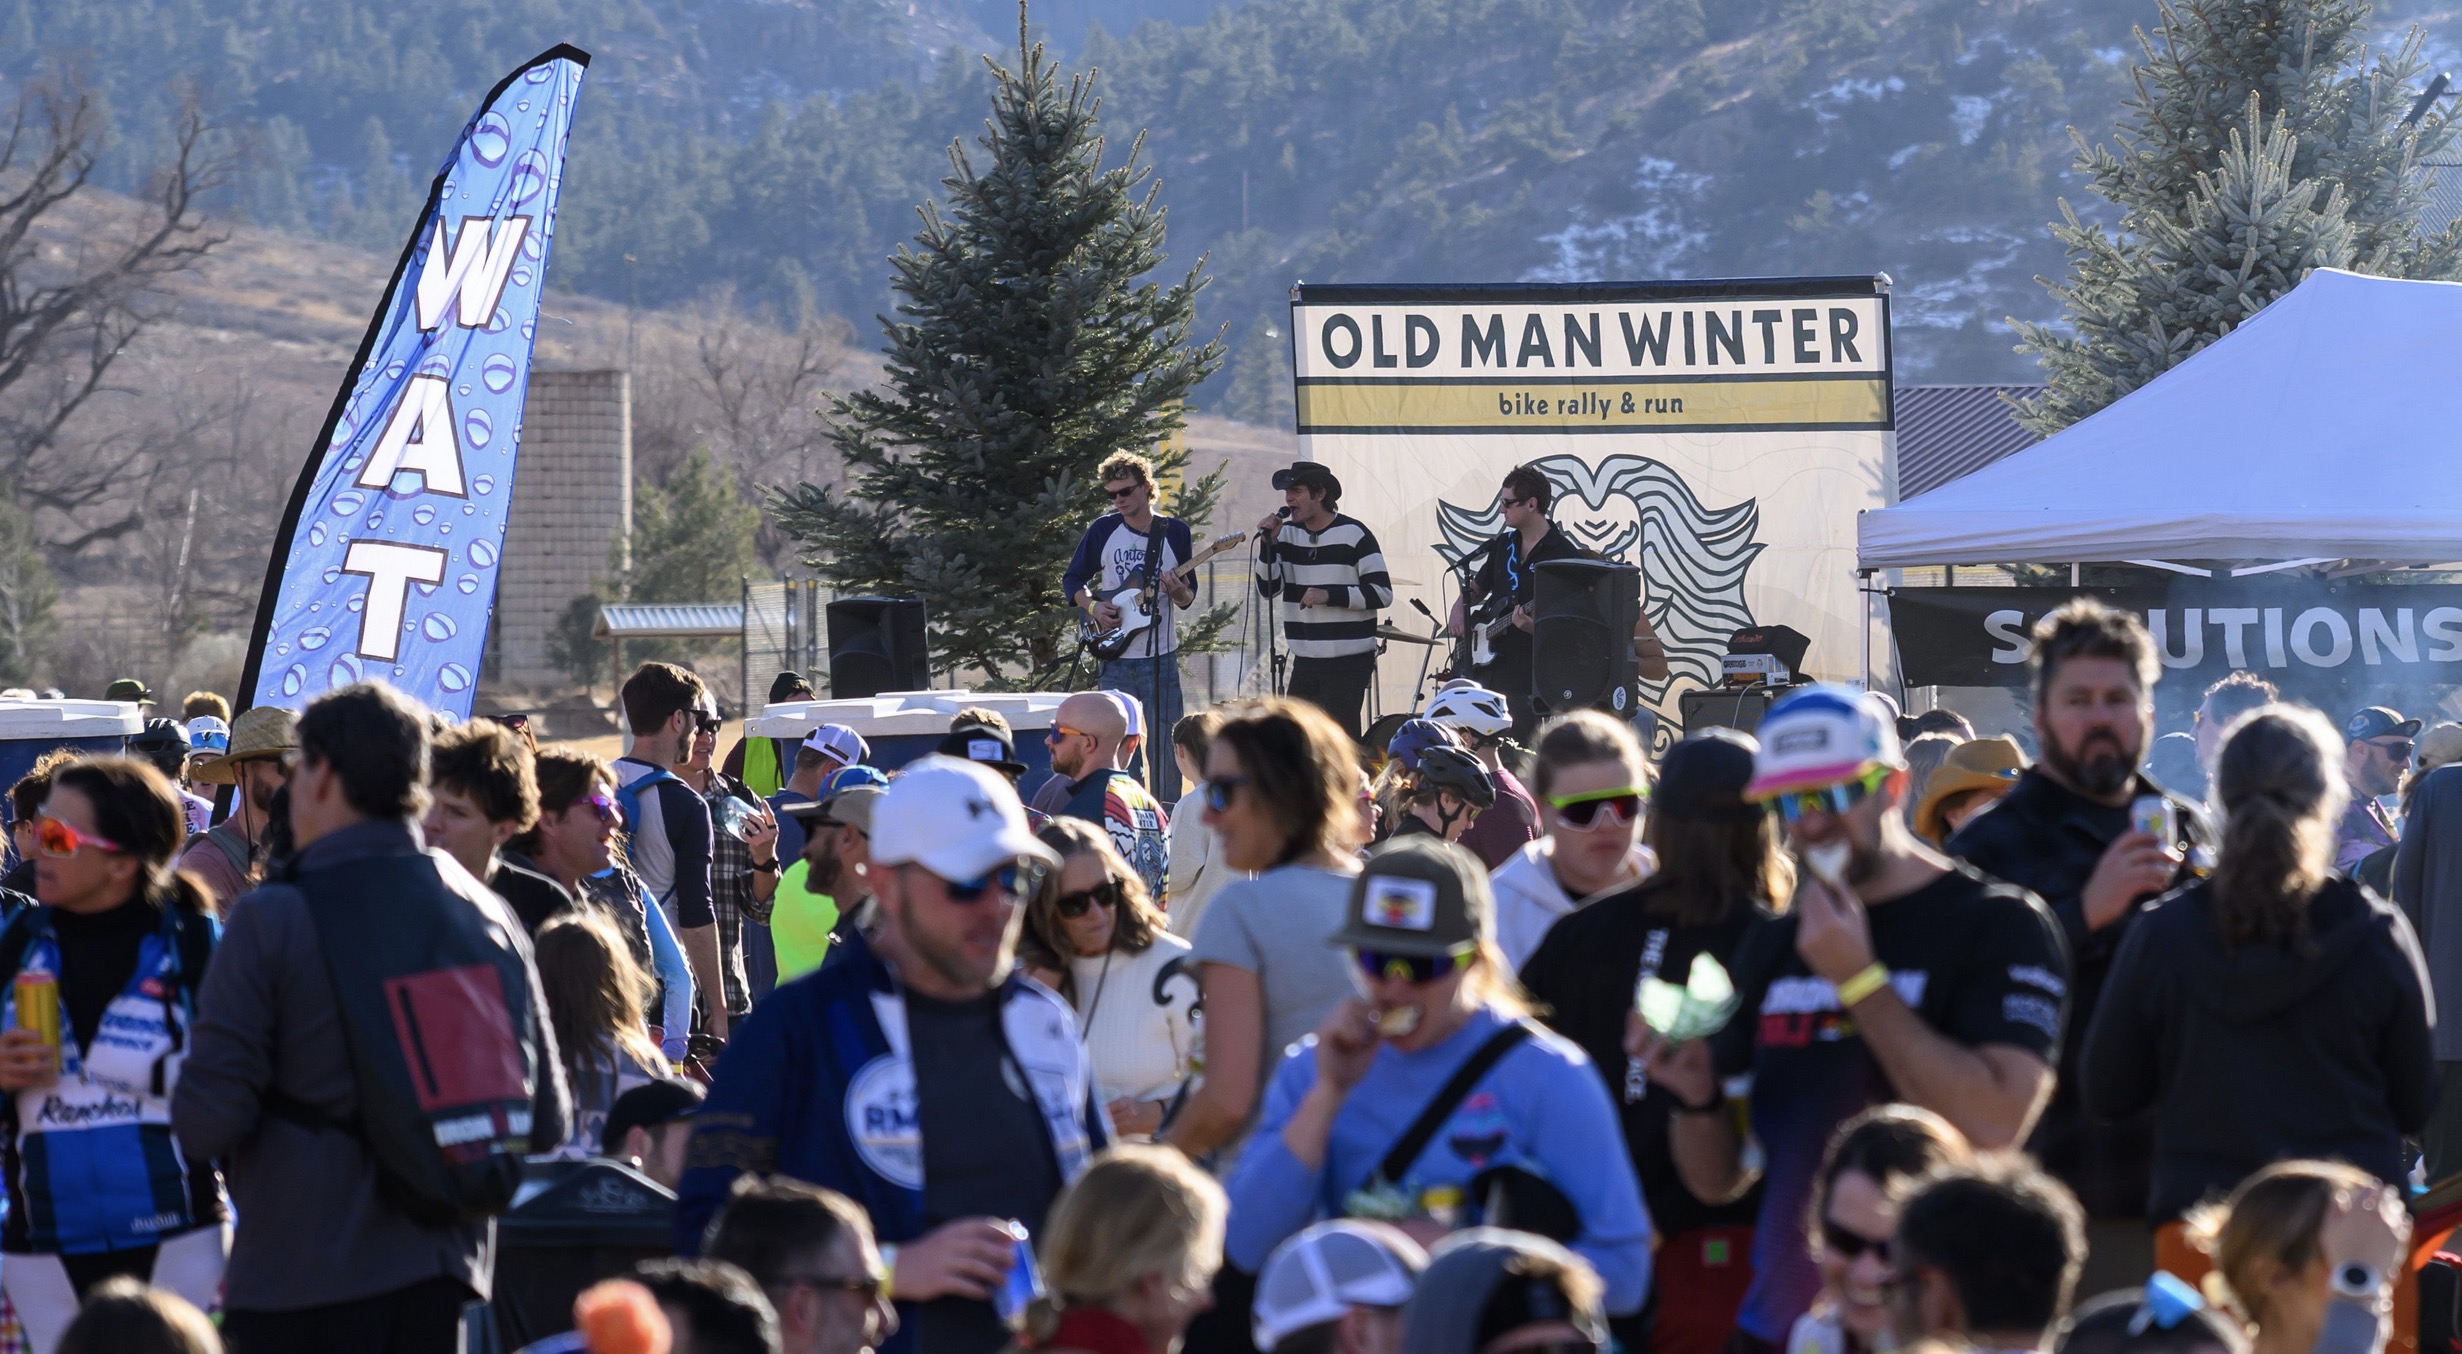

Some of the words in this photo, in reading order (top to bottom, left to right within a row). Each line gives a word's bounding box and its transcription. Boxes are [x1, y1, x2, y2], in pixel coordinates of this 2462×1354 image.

[1320, 312, 1441, 369] OLD
[1461, 312, 1603, 369] MAN
[1618, 307, 1863, 367] WINTER
[1498, 392, 1549, 416] bike
[1557, 391, 1612, 420] rally
[1620, 391, 1636, 414] &
[1644, 396, 1684, 414] run
[1983, 604, 2462, 669] SUTIONS
